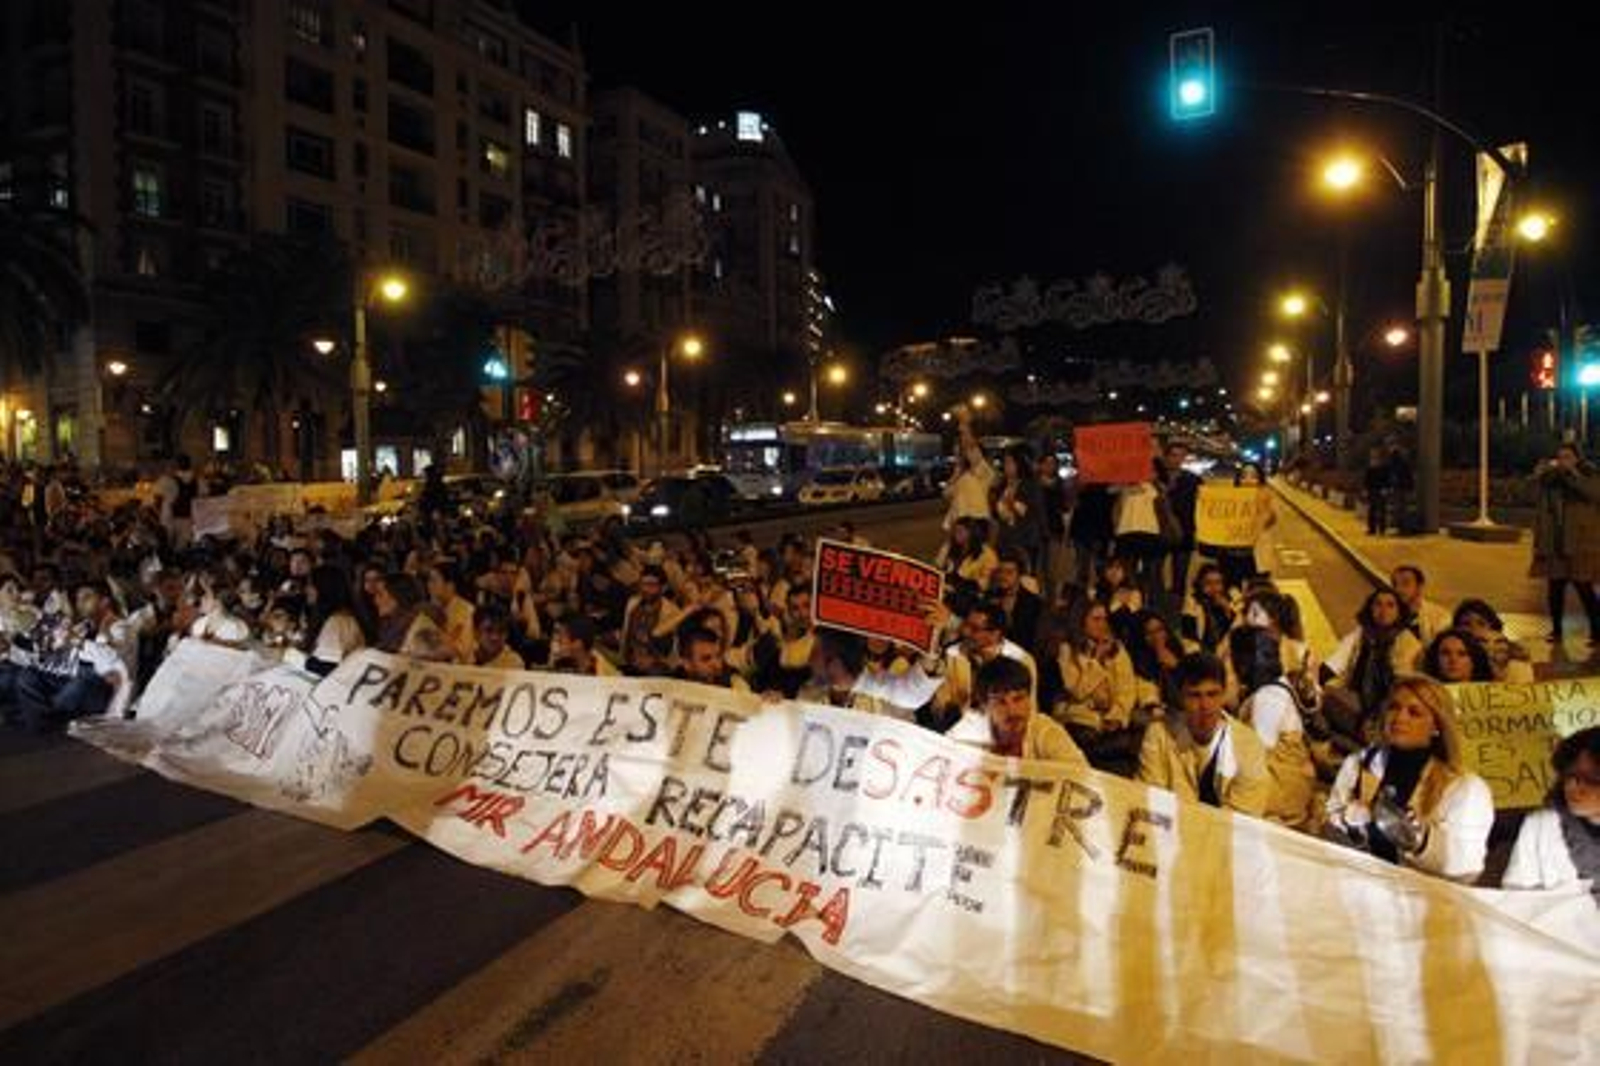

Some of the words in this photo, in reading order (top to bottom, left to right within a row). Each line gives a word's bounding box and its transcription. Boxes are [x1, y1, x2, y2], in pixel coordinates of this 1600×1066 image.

[822, 548, 855, 573] SE
[347, 662, 569, 740] PAREMOS
[589, 692, 751, 773] ESTE
[394, 725, 609, 799] CONSEJERA
[435, 782, 526, 838] MIR
[523, 808, 851, 945] ANDALUCIA
